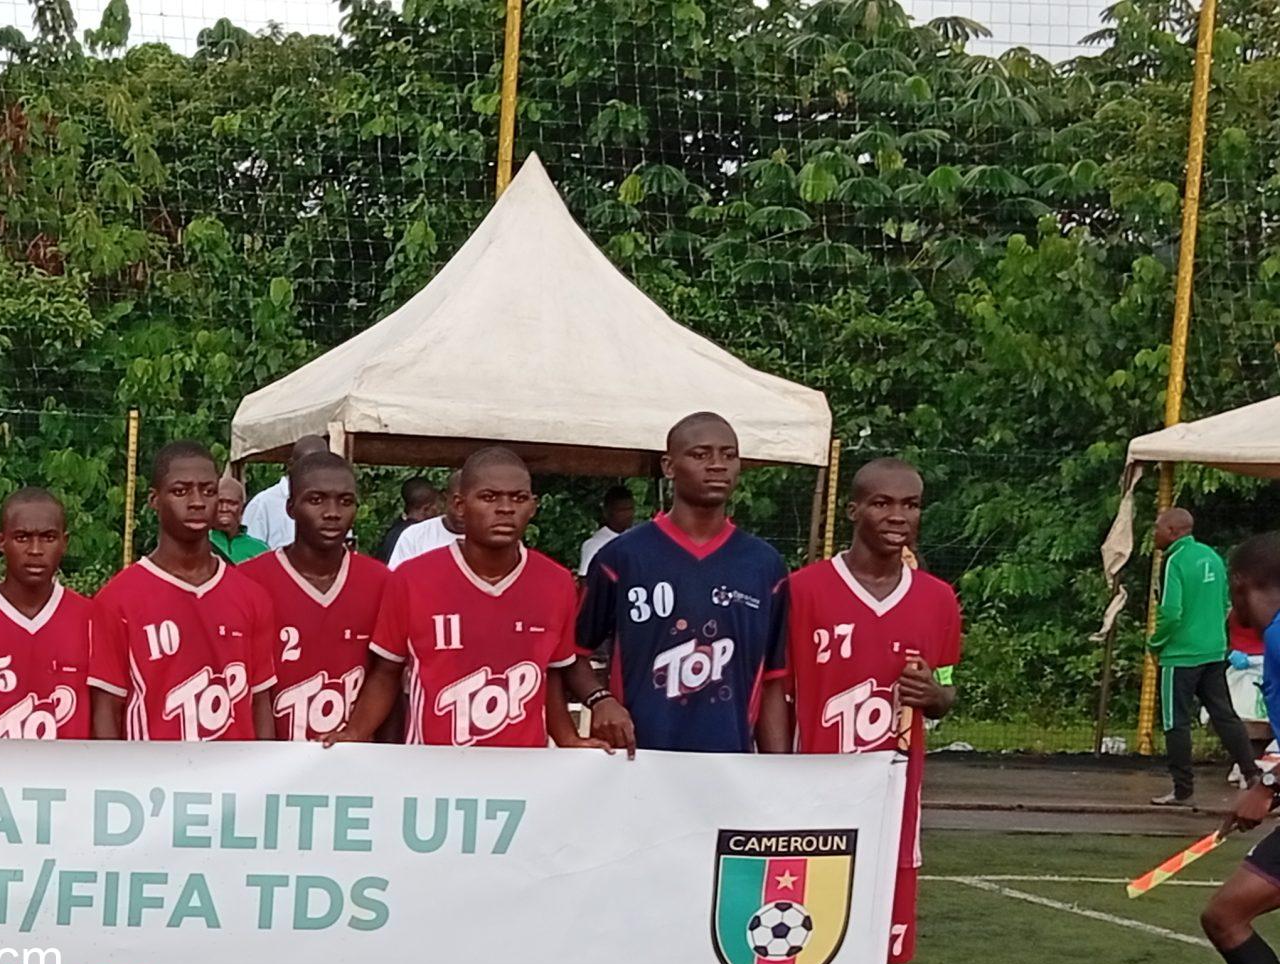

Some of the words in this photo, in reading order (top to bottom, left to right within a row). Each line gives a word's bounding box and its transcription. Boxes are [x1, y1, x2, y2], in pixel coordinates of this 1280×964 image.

[627, 581, 675, 623] 30
[143, 620, 180, 661] 10
[279, 626, 302, 662] 2
[432, 613, 464, 651] 11
[813, 623, 855, 664] 27
[652, 637, 735, 699] TOP
[162, 662, 249, 741] TOP
[436, 661, 542, 746] TOP
[93, 787, 374, 851] D’ELITE
[401, 796, 527, 855] U17
[729, 835, 847, 853] CAMEROUN
[246, 874, 390, 932] TDS
[890, 924, 908, 956] 7
